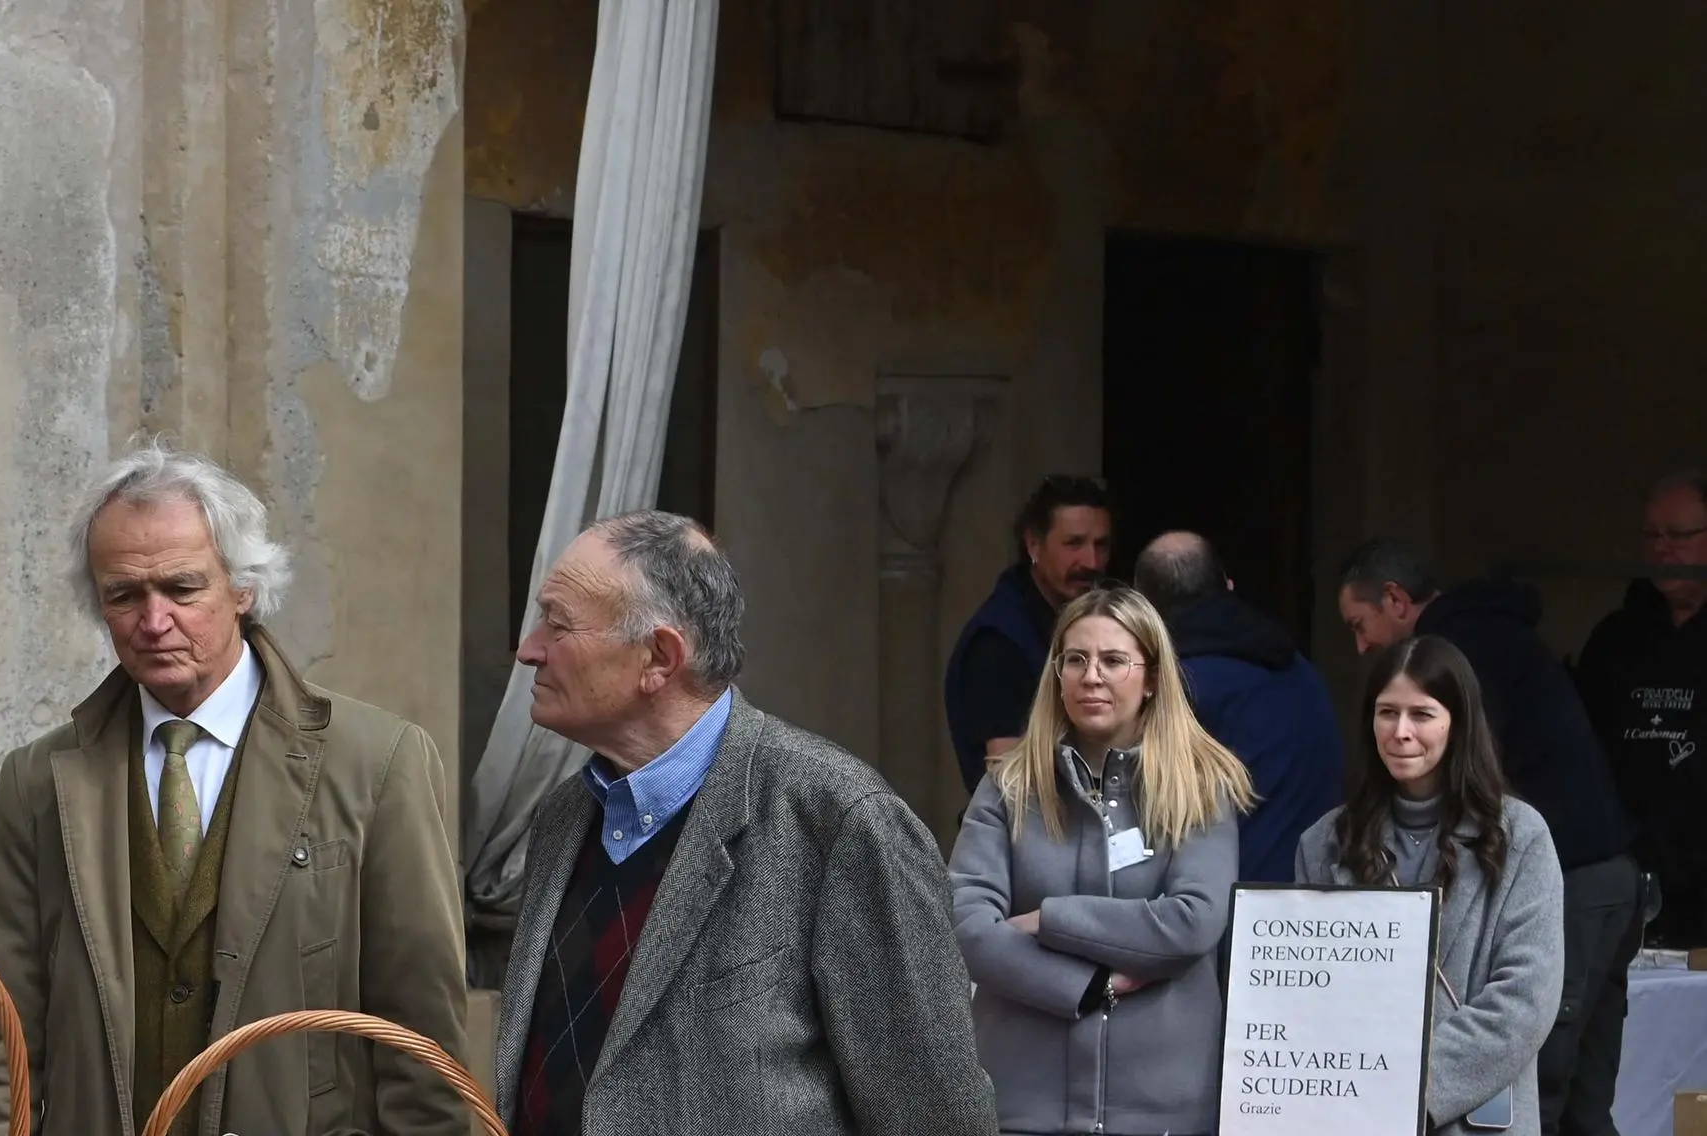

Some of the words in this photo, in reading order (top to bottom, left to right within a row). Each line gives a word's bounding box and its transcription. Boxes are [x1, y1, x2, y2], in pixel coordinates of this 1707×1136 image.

[1252, 919, 1380, 940] CONSEGNA
[1387, 921, 1401, 939] E
[1250, 945, 1395, 963] PRENOTAZIONI
[1248, 969, 1331, 988] SPIEDO
[1245, 1023, 1288, 1041] PER
[1243, 1050, 1352, 1070] SALVARE
[1358, 1053, 1390, 1071] LA
[1241, 1077, 1360, 1097] SCUDERIA
[1239, 1102, 1282, 1116] Grazie
